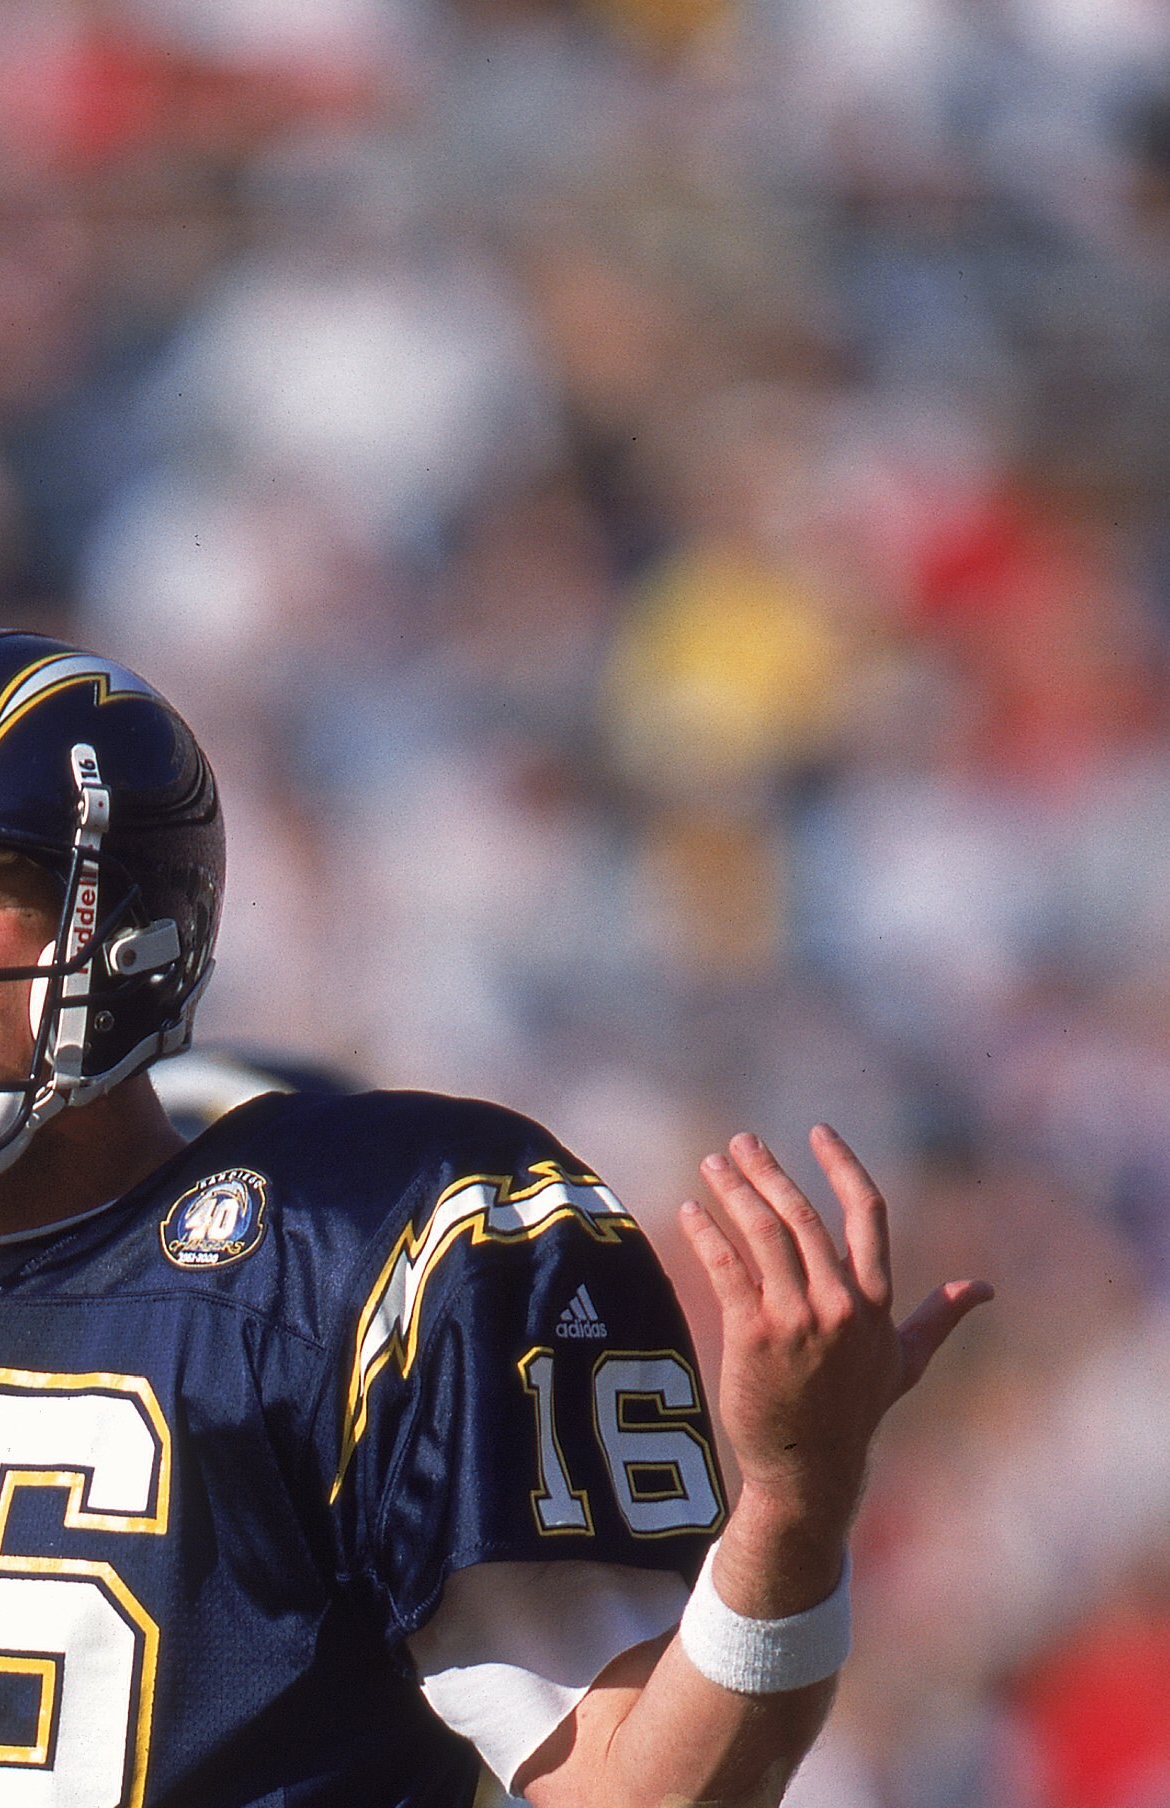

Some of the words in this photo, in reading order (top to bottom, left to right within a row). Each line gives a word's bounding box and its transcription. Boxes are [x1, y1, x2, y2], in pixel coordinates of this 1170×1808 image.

[79, 758, 96, 779] 16
[69, 866, 96, 975] ddell
[556, 1320, 607, 1338] adidas
[517, 1345, 726, 1539] 16
